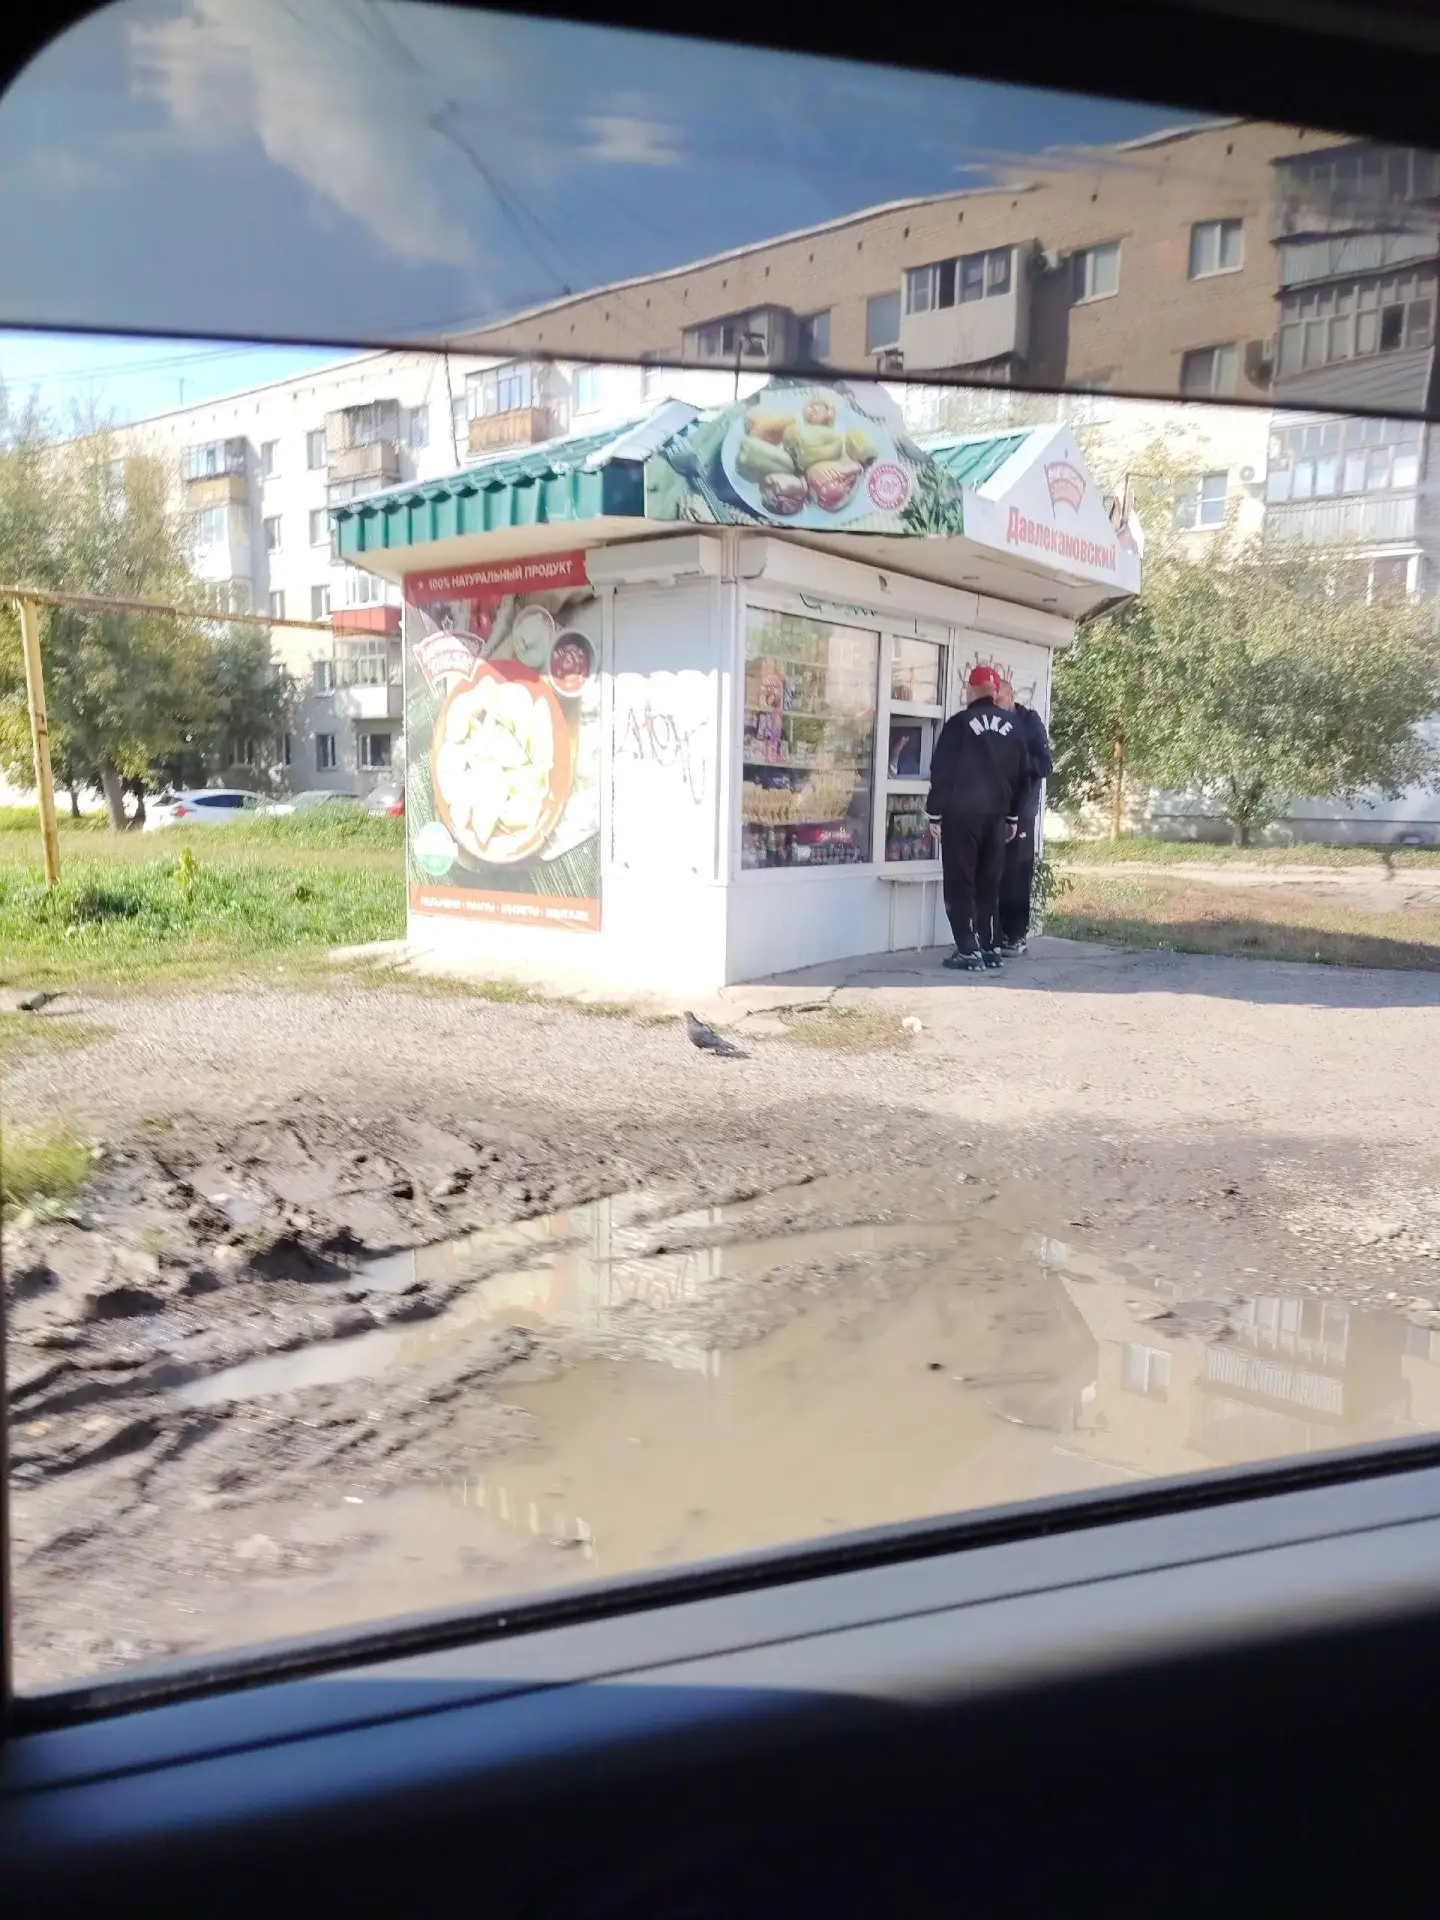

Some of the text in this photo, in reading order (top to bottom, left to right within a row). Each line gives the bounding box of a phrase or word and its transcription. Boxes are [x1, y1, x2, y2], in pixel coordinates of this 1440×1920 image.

[1007, 505, 1116, 571] Давлекановский
[428, 560, 573, 591] 100% НАТУРАЛЬНЫЙ ПРОДУКТ
[969, 714, 1013, 737] NIKE
